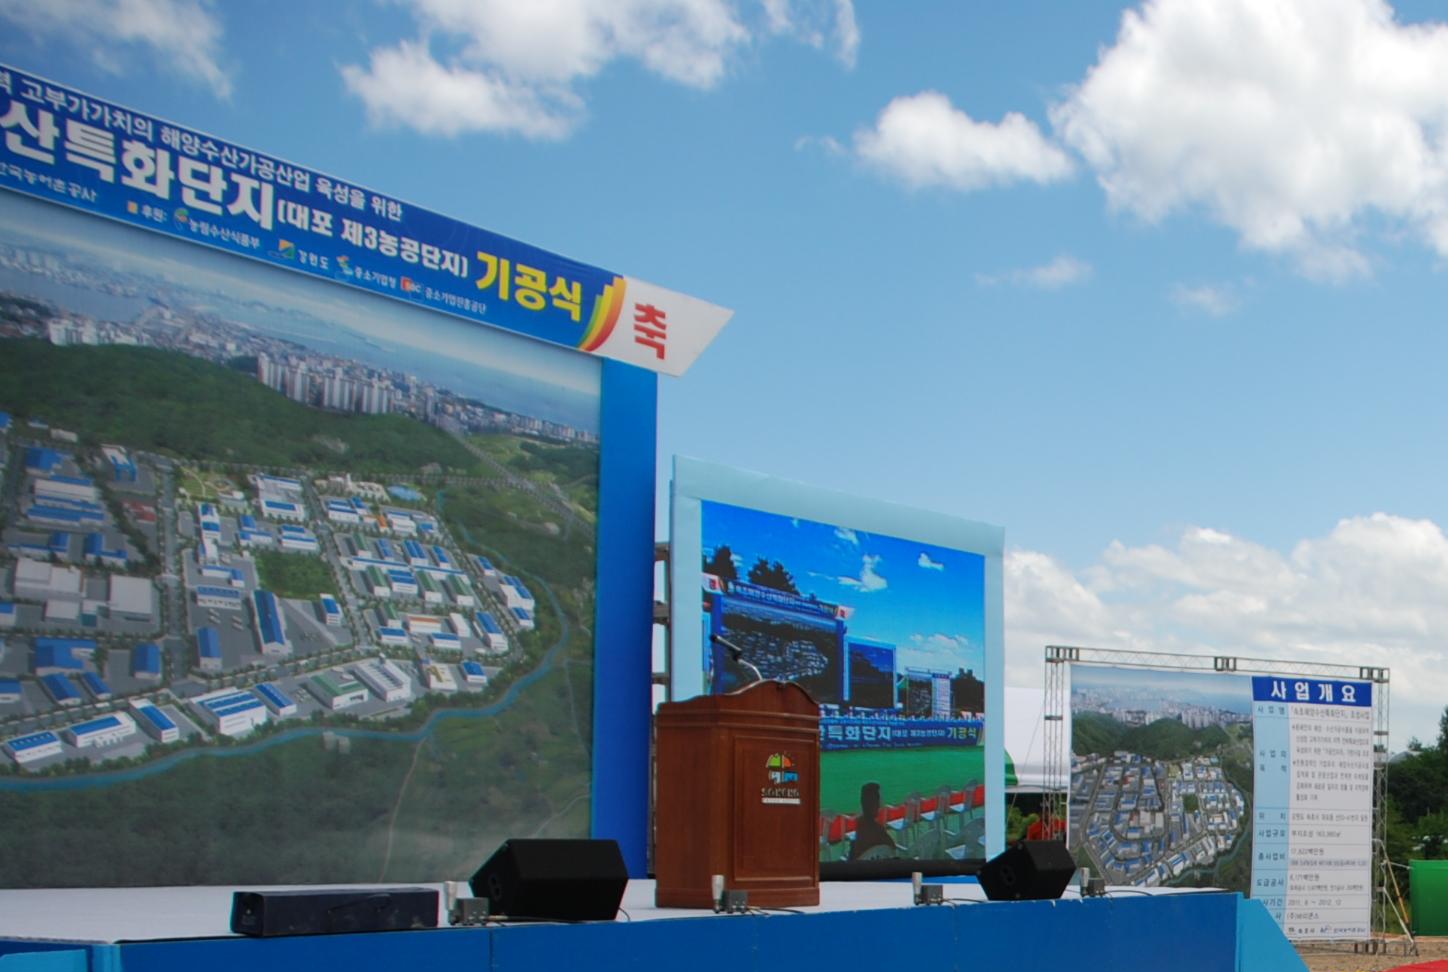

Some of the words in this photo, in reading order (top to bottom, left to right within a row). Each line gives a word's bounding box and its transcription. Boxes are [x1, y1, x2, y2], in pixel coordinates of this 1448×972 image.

[20, 79, 153, 143] 고부가가치의
[160, 125, 311, 193] 해양수산가공산업
[315, 177, 366, 211] 육성을
[371, 195, 403, 222] 위한
[0, 99, 274, 231] 산특화단지
[277, 199, 334, 237] (대포
[340, 217, 468, 279] 제3농공단지)
[476, 250, 583, 323] 기공식
[633, 302, 668, 360] 축
[1270, 680, 1357, 703] 사업개요
